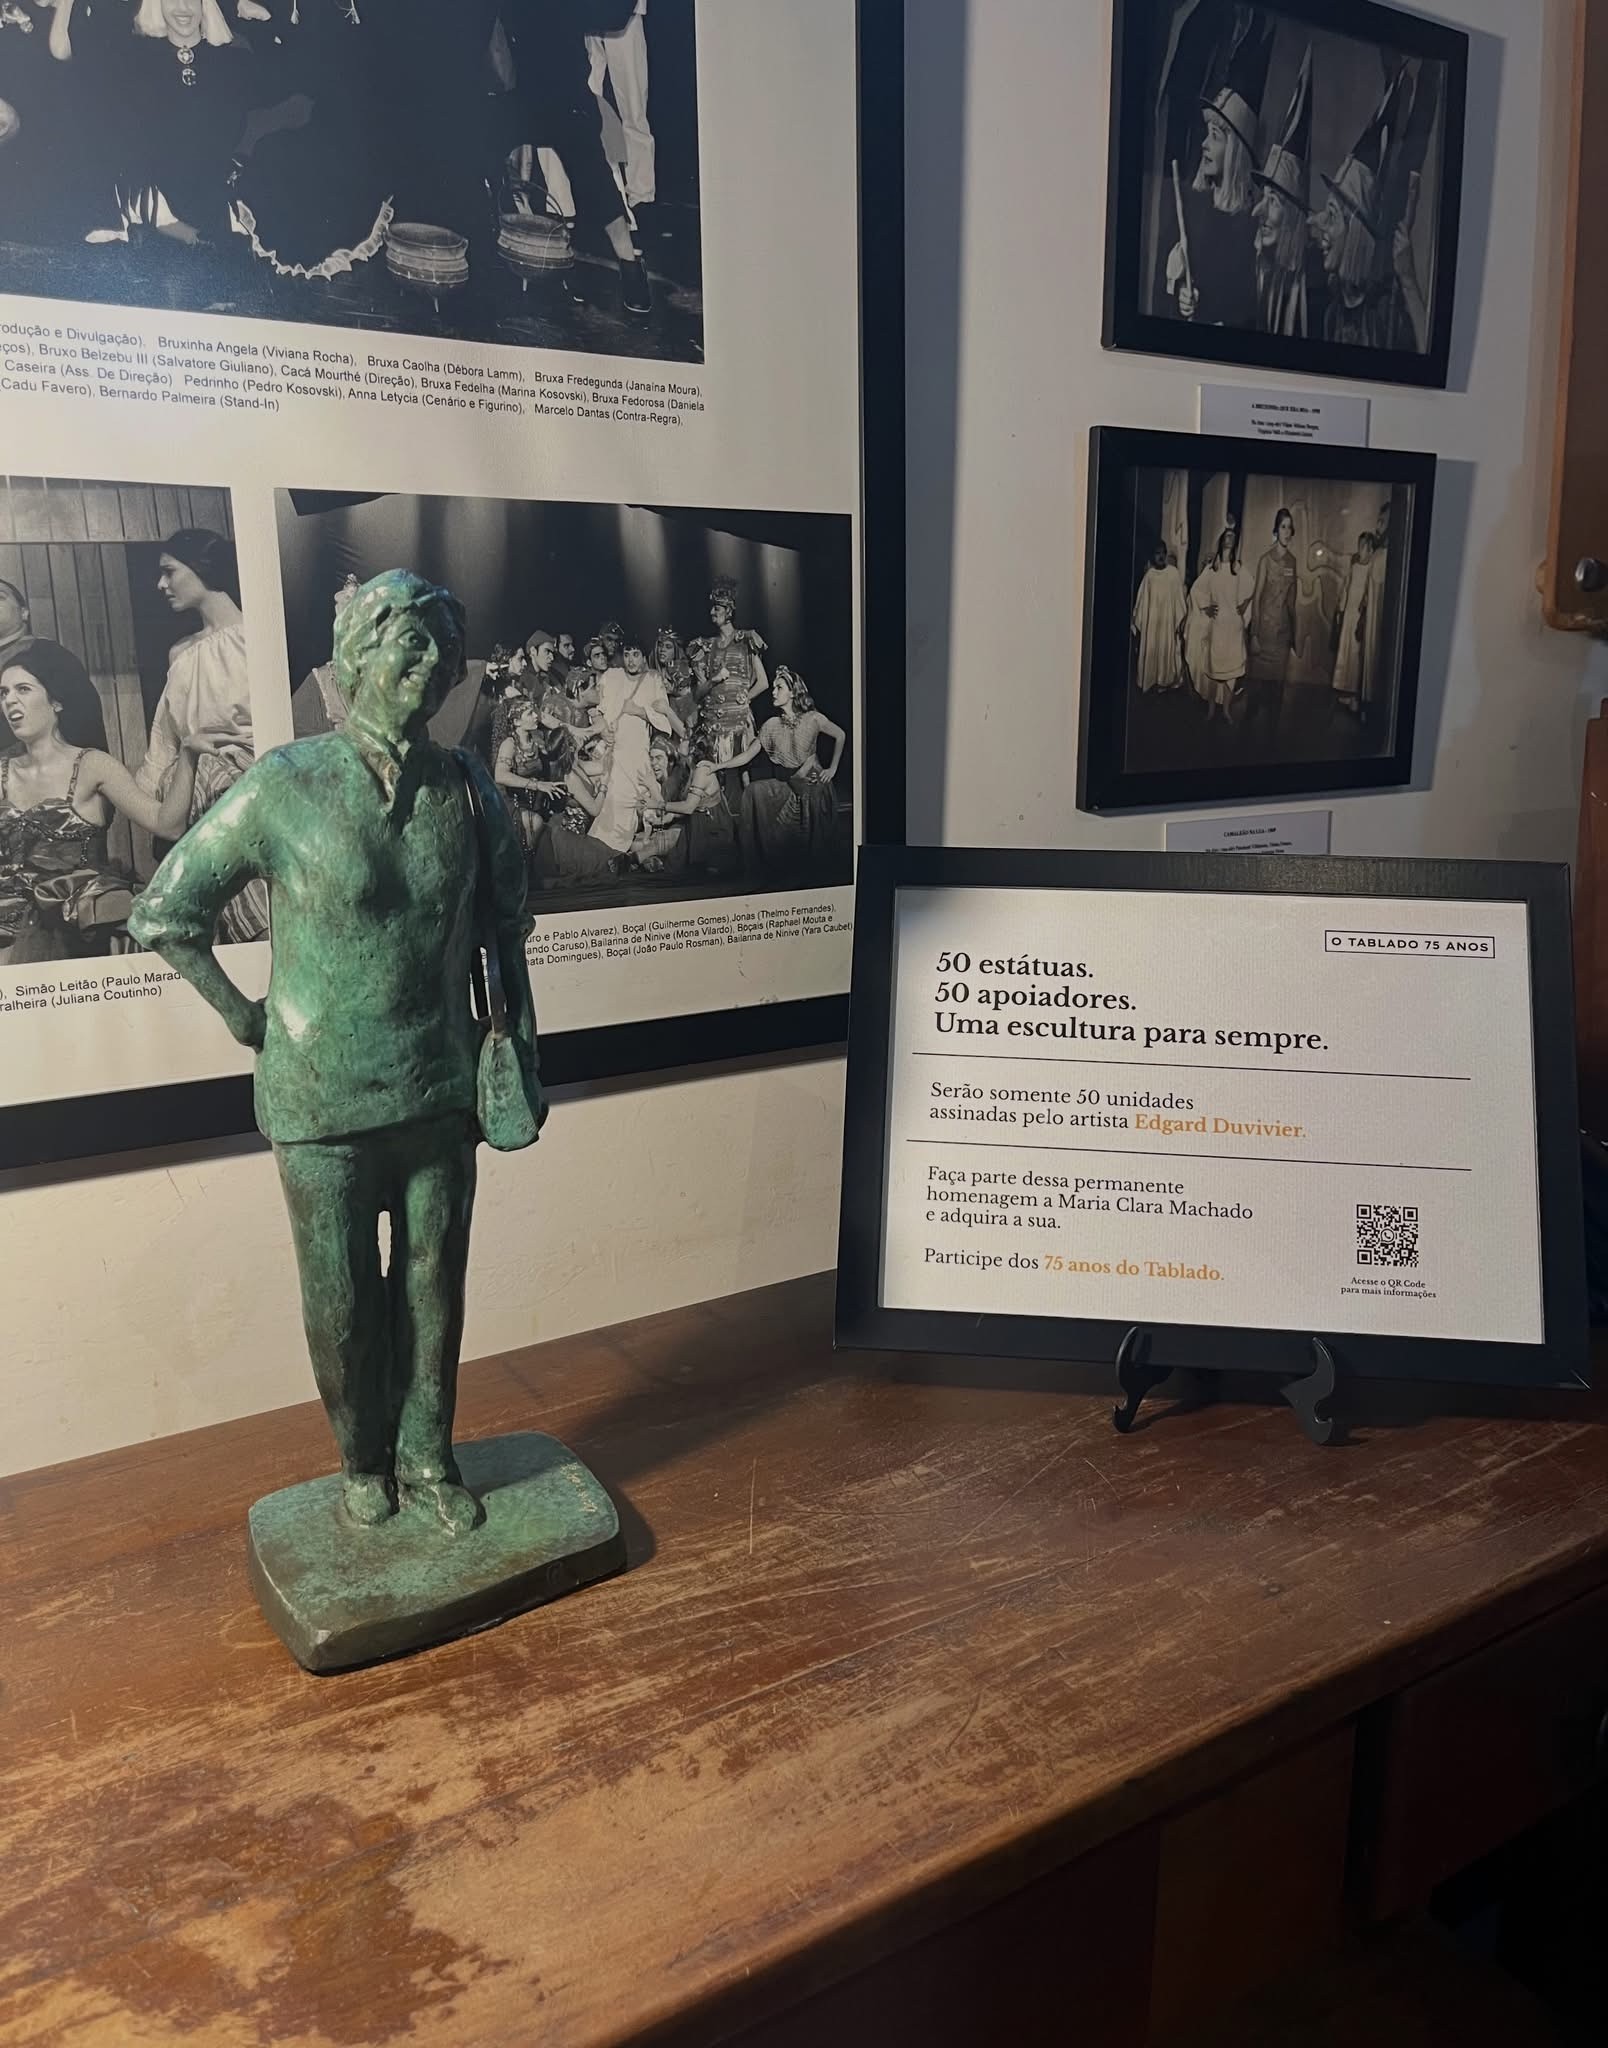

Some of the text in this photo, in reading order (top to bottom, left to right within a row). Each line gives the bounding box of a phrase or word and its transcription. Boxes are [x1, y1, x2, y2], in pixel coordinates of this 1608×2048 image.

[0, 343, 34, 356] ços),
[39, 344, 77, 358] Bruxo
[81, 347, 132, 363] Belzebu
[137, 352, 147, 365] III
[153, 354, 216, 370] (Salvatore
[220, 360, 276, 377] Giuliano),
[281, 365, 311, 377] Cacá
[315, 368, 360, 382] Mourthé
[421, 377, 451, 390] Bruxa
[540, 388, 589, 403] Kosovski),
[592, 392, 618, 404] Bruxa
[622, 395, 664, 408] Fedorosa
[668, 399, 704, 411] (Daniela
[55, 329, 62, 338] e
[158, 336, 213, 352] Bruxinha
[263, 346, 309, 360] (Viviana
[313, 350, 356, 367] Rocha),
[368, 356, 399, 368] Bruxa
[403, 359, 440, 372] Caolha
[487, 368, 525, 383] Lamm),
[535, 372, 563, 383] Bruxa
[567, 374, 622, 389] Fredegunda
[669, 384, 702, 397] Moura),
[5, 360, 56, 374] Caseira
[97, 367, 115, 380] De
[184, 375, 239, 391] Pedrinho
[243, 379, 282, 392] (Pedro
[287, 383, 345, 399] Kosovski),
[348, 388, 376, 400] Anna
[381, 390, 418, 405] Letycia
[469, 400, 475, 408] e
[478, 399, 525, 414] Figurino),
[535, 404, 574, 416] Marcelo
[577, 407, 610, 419] Dantas
[613, 409, 682, 425] (Contra-Regra),
[42, 380, 95, 397] Favero),
[99, 385, 157, 401] Bernardo
[162, 391, 215, 405] Palmeira
[220, 395, 279, 412] (Stand-In)
[553, 930, 579, 941] Pablo
[622, 923, 646, 935] Boçal
[649, 920, 695, 932] (Guilherme
[631, 935, 642, 943] de
[673, 929, 699, 941] (Mona
[737, 922, 763, 933] Boçais
[766, 917, 800, 930] (Raphael
[803, 916, 826, 924] Mouta
[547, 950, 603, 963] Domingues),
[607, 946, 630, 957] Boçal
[633, 944, 657, 956] (João
[660, 941, 683, 951] Paulo
[764, 931, 773, 939] de
[802, 925, 821, 936] (Yara
[1332, 937, 1488, 951] O TABLADO 75 ANOS
[936, 952, 1093, 977] 50 estátuas.
[16, 984, 55, 996] Simão
[60, 980, 98, 991] Leitão
[102, 975, 140, 991] (Paulo
[51, 994, 99, 1008] (Juliana
[104, 985, 161, 1000] Coutinho)
[935, 982, 1136, 1011] 50 apoiadores.
[935, 1012, 1328, 1054] Uma escultura para sempre.
[931, 1082, 1193, 1109] Serão somente 50 unidades
[930, 1104, 1306, 1137] assinadas pelo artista Edgard Duvivier.
[928, 1166, 1183, 1194] Faça parte dessa permanente
[927, 1186, 1252, 1219] homenagem a Maria Clara Machado
[926, 1208, 1060, 1228] e adquira a sua.
[925, 1249, 1224, 1280] Participe dos 75 anos do Tablado.
[1351, 1277, 1378, 1285] Acesse
[1388, 1279, 1402, 1288] QR
[1404, 1280, 1425, 1288] Code
[1384, 1287, 1436, 1299] informações
